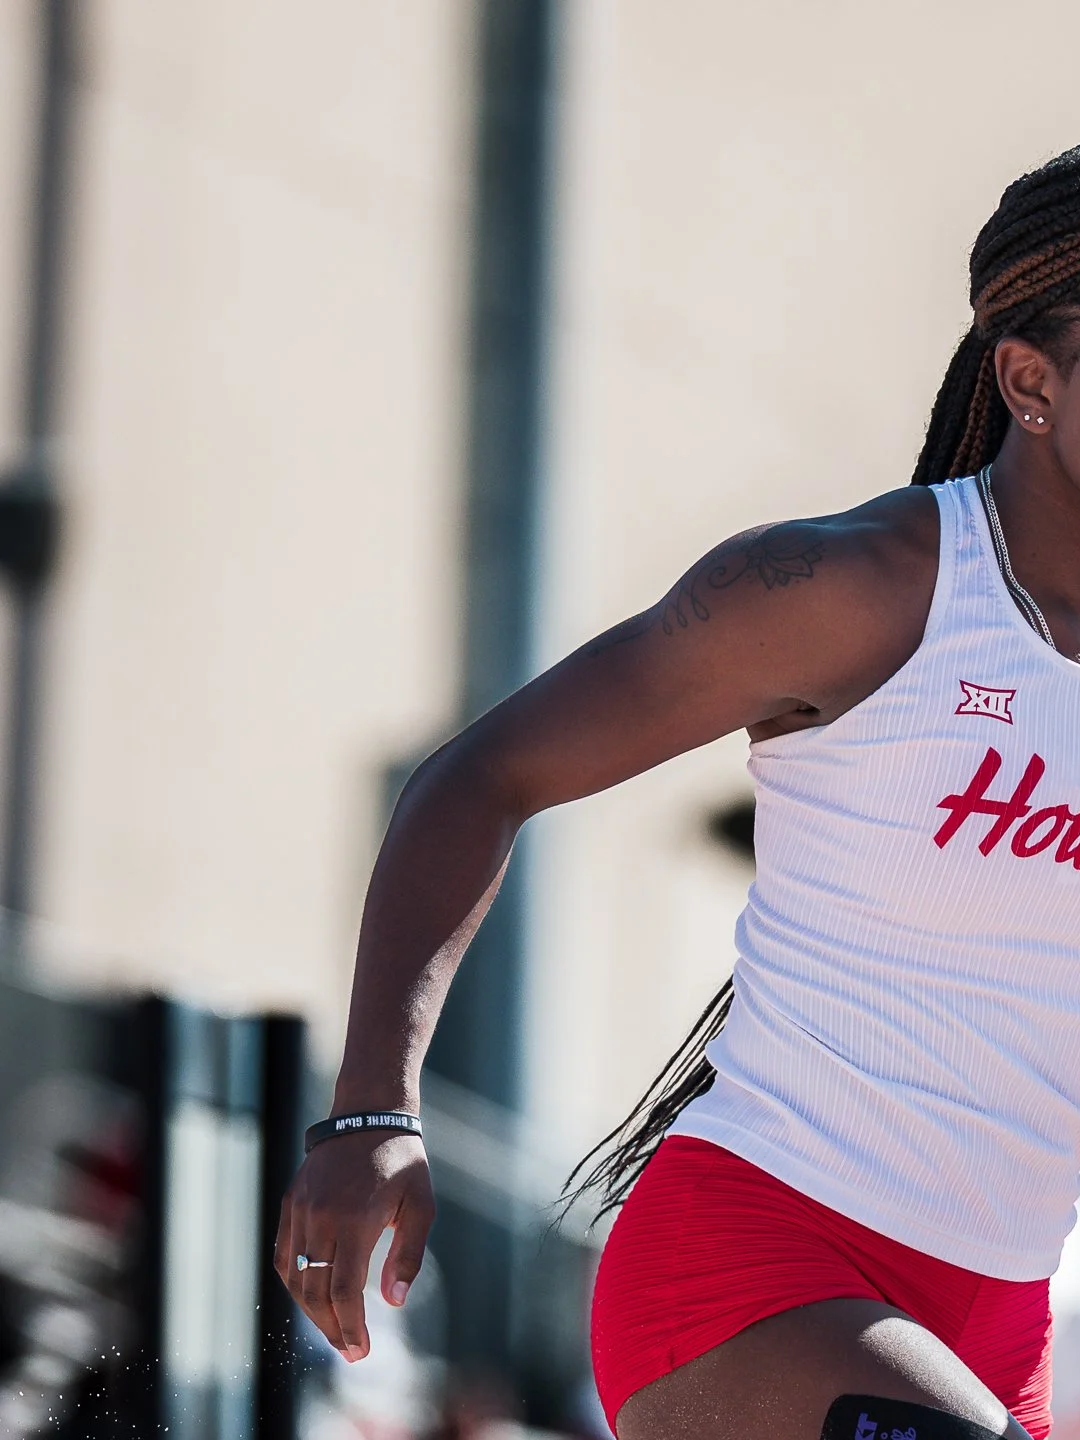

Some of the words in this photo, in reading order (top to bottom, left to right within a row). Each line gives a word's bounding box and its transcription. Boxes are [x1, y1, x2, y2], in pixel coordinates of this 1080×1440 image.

[956, 681, 1016, 724] XII
[335, 1116, 363, 1131] GLOW
[366, 1115, 408, 1128] BREATHE
